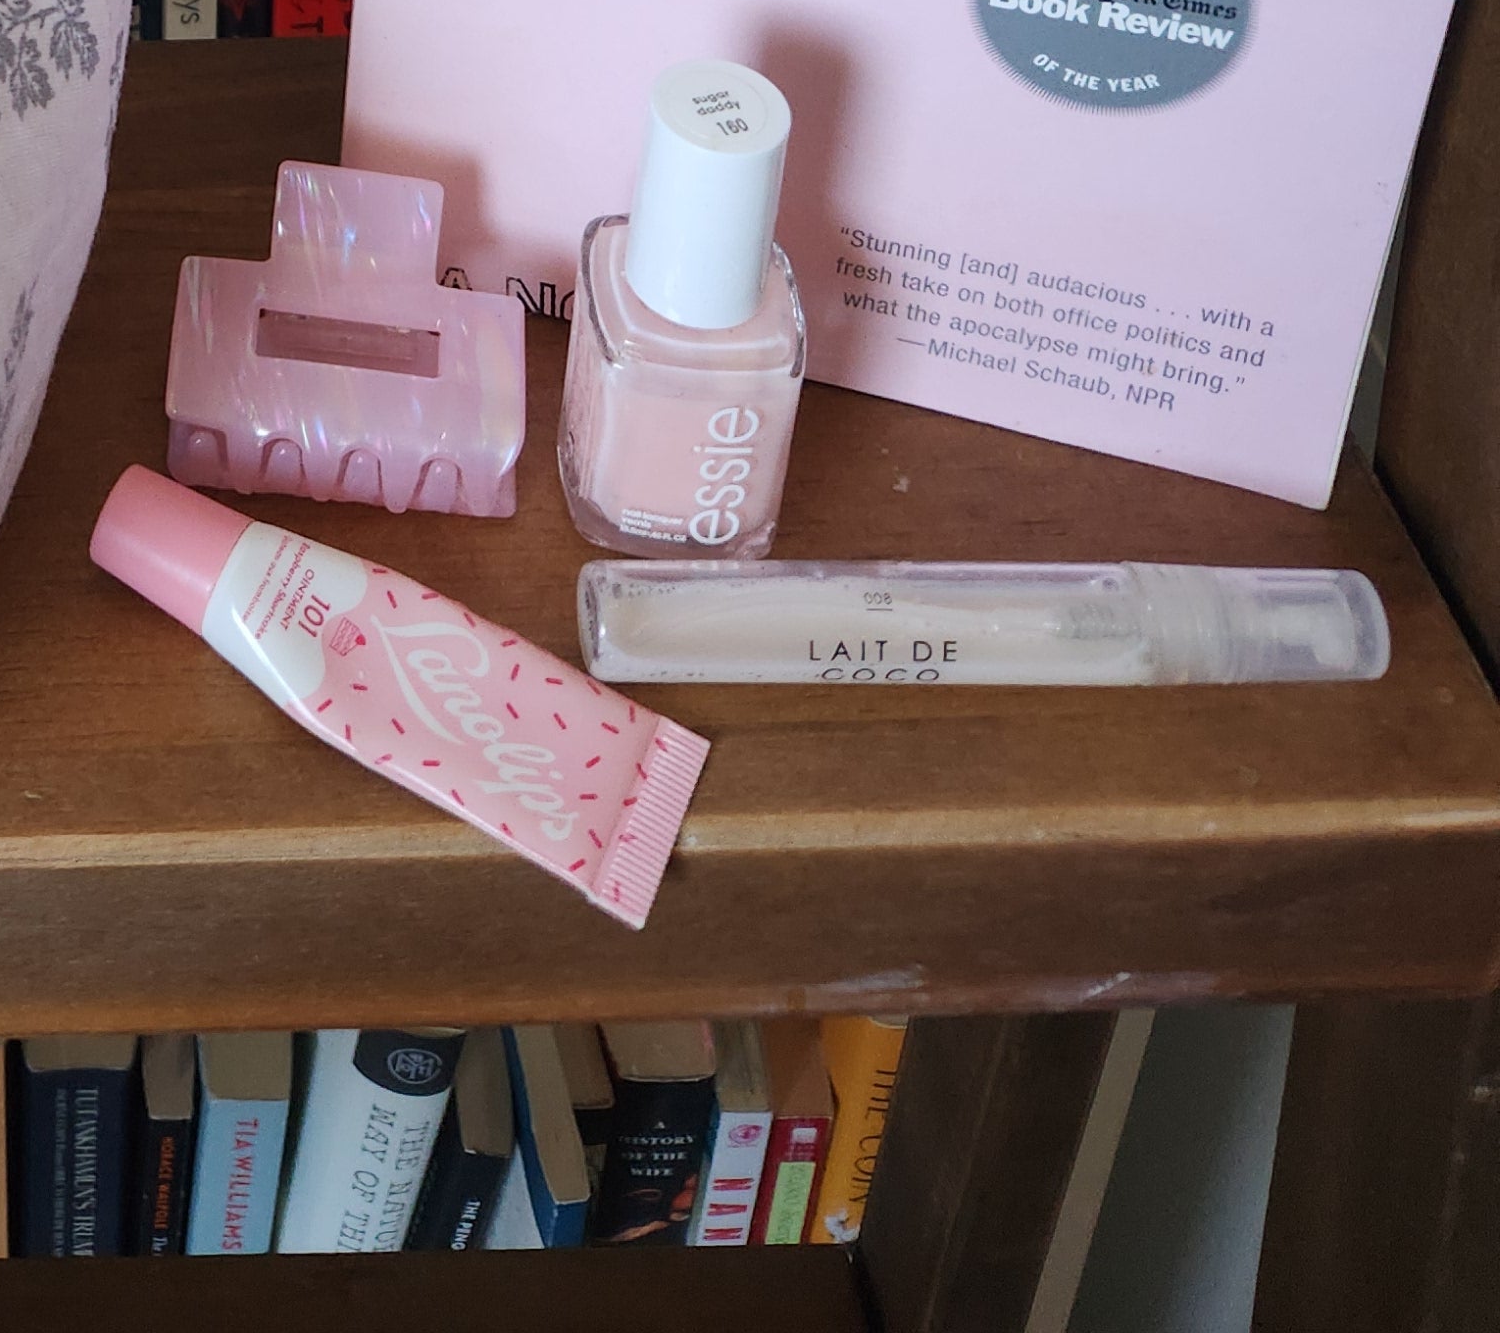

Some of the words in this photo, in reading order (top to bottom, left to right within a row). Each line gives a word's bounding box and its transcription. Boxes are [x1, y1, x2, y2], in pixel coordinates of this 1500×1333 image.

[1096, 0, 1236, 50] Review
[1032, 53, 1060, 73] OF
[1062, 68, 1101, 92] THE
[1106, 73, 1161, 93] YEAR
[716, 117, 749, 136] 160
[840, 225, 952, 271] “Stunning
[959, 251, 1020, 287] [and]
[1026, 270, 1147, 310] audacious
[1200, 306, 1253, 336] with
[1259, 319, 1275, 337] a
[835, 256, 893, 287] fresh
[900, 271, 950, 299] take
[957, 286, 986, 307] on
[994, 290, 1045, 319] both
[1052, 305, 1118, 335] office
[1125, 320, 1212, 356] politics
[1219, 342, 1266, 369] and
[842, 290, 900, 318] what
[905, 301, 941, 327] the
[948, 312, 1079, 358] apocalypse
[1086, 342, 1155, 377] might
[1162, 359, 1247, 396] bring.”
[1024, 359, 1117, 400] Schaub,
[1125, 383, 1176, 412] NPR
[688, 406, 760, 546] essie
[280, 568, 316, 631] OINTMENT
[297, 593, 332, 638] 101
[863, 591, 893, 605] 008
[809, 640, 889, 662] LAIT
[912, 640, 958, 662] DE
[820, 667, 941, 682] COCO
[370, 613, 577, 843] Lanolips
[232, 1117, 260, 1152] TIA
[618, 1134, 695, 1146] HISTORY
[652, 1150, 688, 1161] THE
[156, 1136, 175, 1179] HORACE
[220, 1158, 253, 1251] WILLIAMS
[461, 1198, 482, 1220] THE
